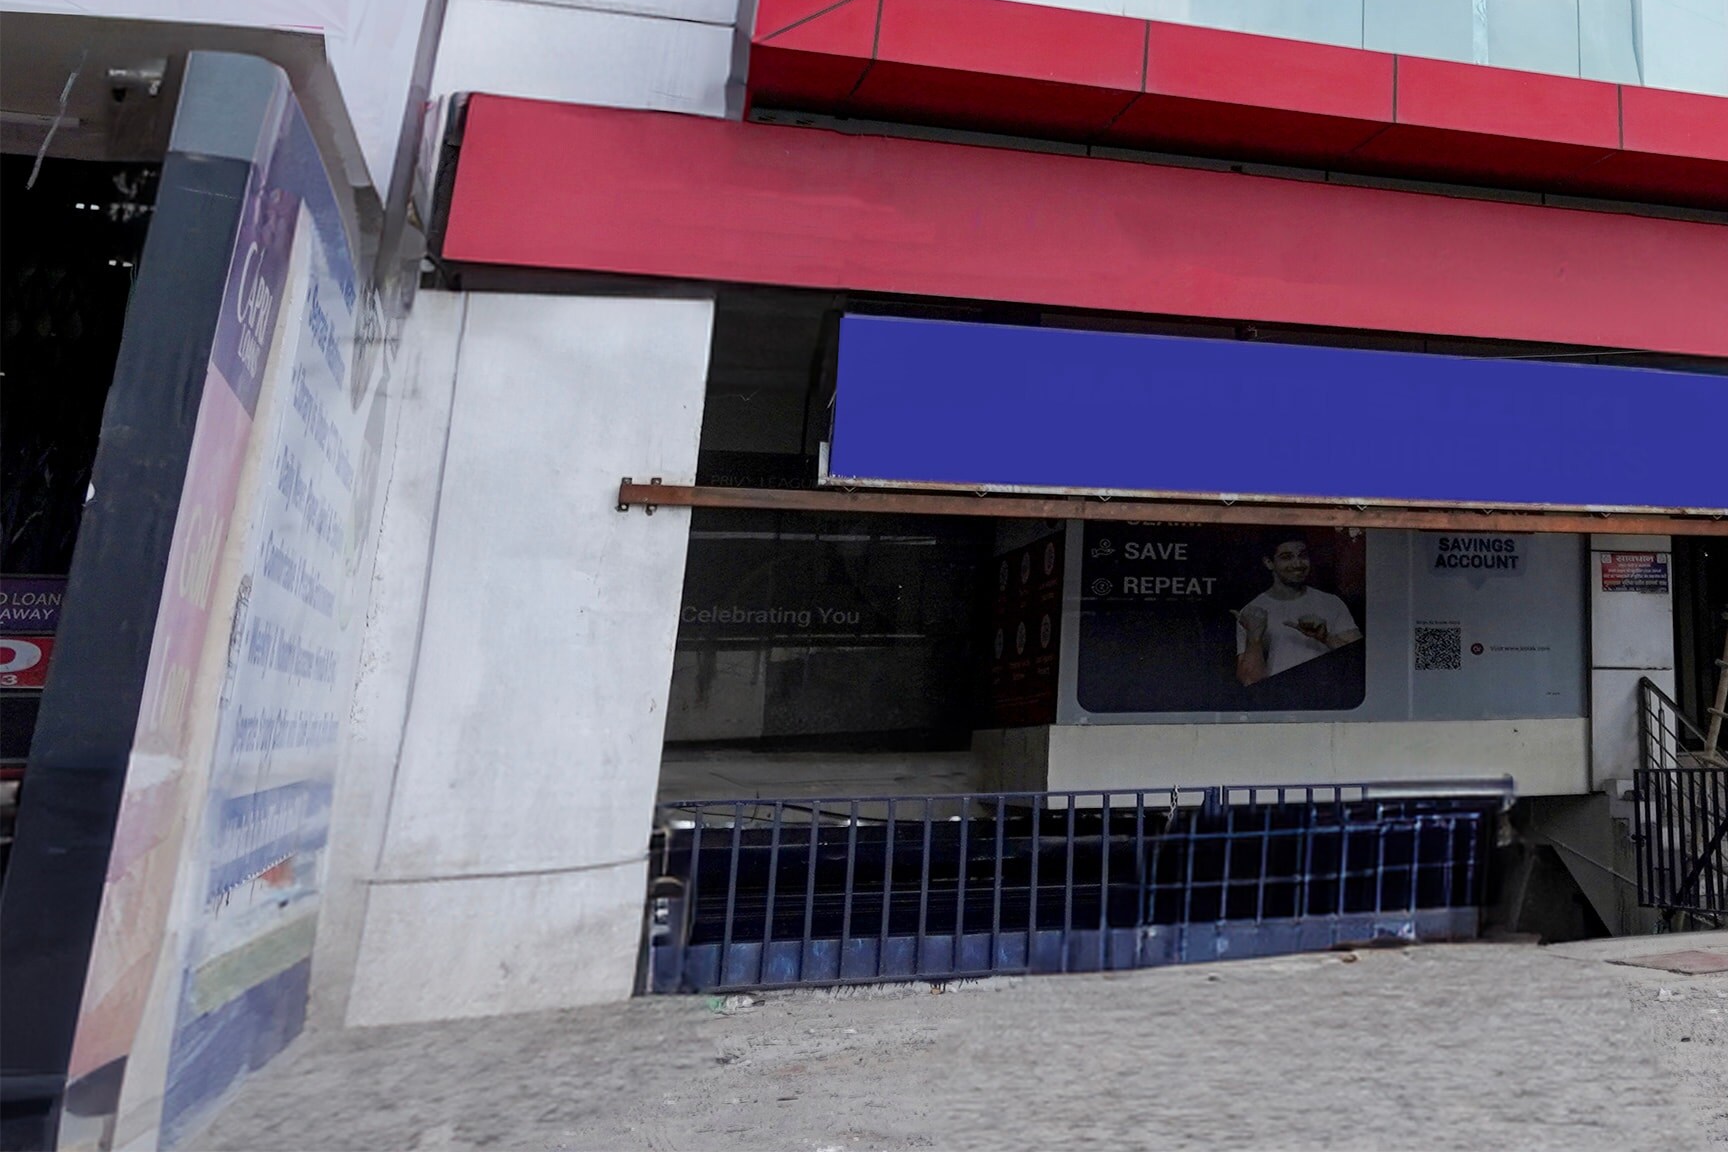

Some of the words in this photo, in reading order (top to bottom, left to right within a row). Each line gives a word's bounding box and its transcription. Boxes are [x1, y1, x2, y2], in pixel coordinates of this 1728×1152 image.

[237, 241, 273, 347] CAPRI
[1124, 542, 1188, 562] SAVE
[1438, 537, 1515, 553] SAVINGS
[179, 504, 225, 612] Gold
[1434, 554, 1519, 569] ACCOUNT
[1122, 576, 1217, 596] REPEAT
[13, 592, 62, 606] LOAN
[681, 606, 812, 628] Celebrating
[818, 608, 860, 625] You
